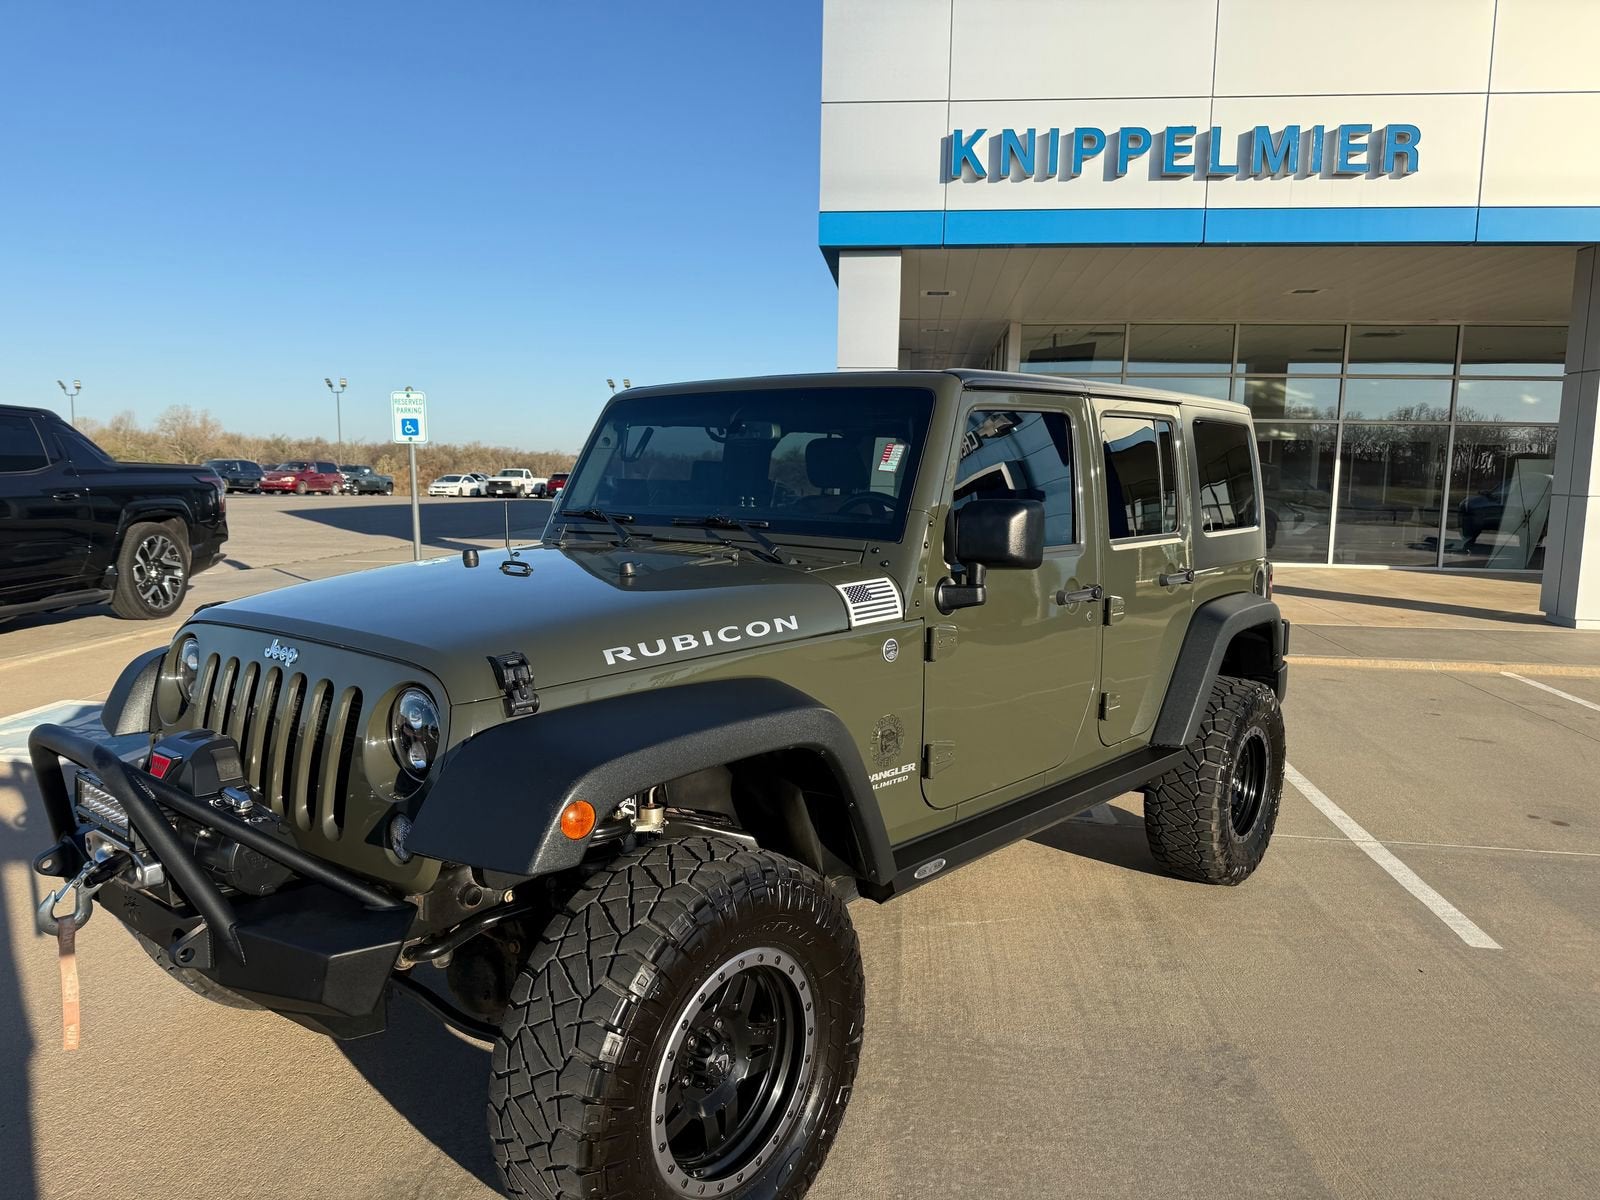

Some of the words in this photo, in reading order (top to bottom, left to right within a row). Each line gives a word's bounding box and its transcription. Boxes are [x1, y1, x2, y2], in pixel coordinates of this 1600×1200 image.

[951, 124, 1422, 179] KNIPPELMIER
[264, 638, 299, 668] Jeep
[602, 615, 799, 666] RUBICON
[868, 762, 916, 782] ANGLER
